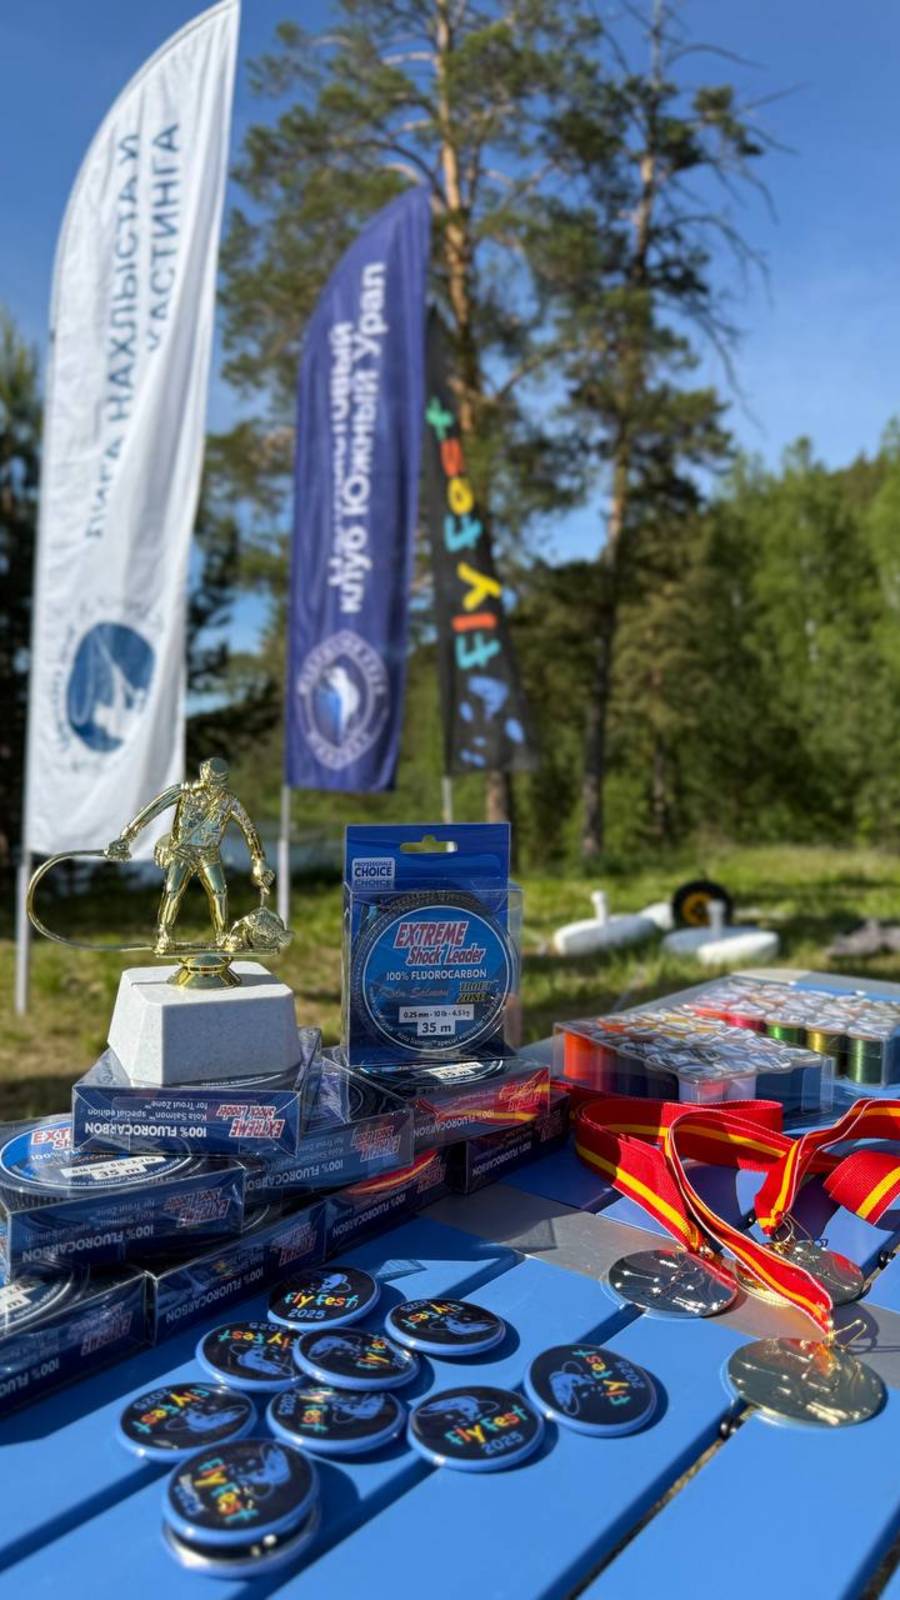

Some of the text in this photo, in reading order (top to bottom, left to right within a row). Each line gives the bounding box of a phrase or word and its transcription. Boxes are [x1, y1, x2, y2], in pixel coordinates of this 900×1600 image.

[350, 261, 389, 363] Урал
[354, 866, 393, 877] CHOICE
[395, 922, 468, 948] EXTREME
[407, 943, 486, 965] Shock Leader
[411, 968, 487, 981] FLUOROCARBON
[422, 1022, 452, 1033] 35 m
[122, 1109, 146, 1119] special
[84, 1122, 207, 1137] 100% FLUOROCARBON
[229, 1119, 285, 1138] EXTREME
[22, 1231, 124, 1263] FLUOROCARBON
[288, 1308, 326, 1319] 2025
[614, 1360, 646, 1390] 2025
[481, 1430, 524, 1456] 2025
